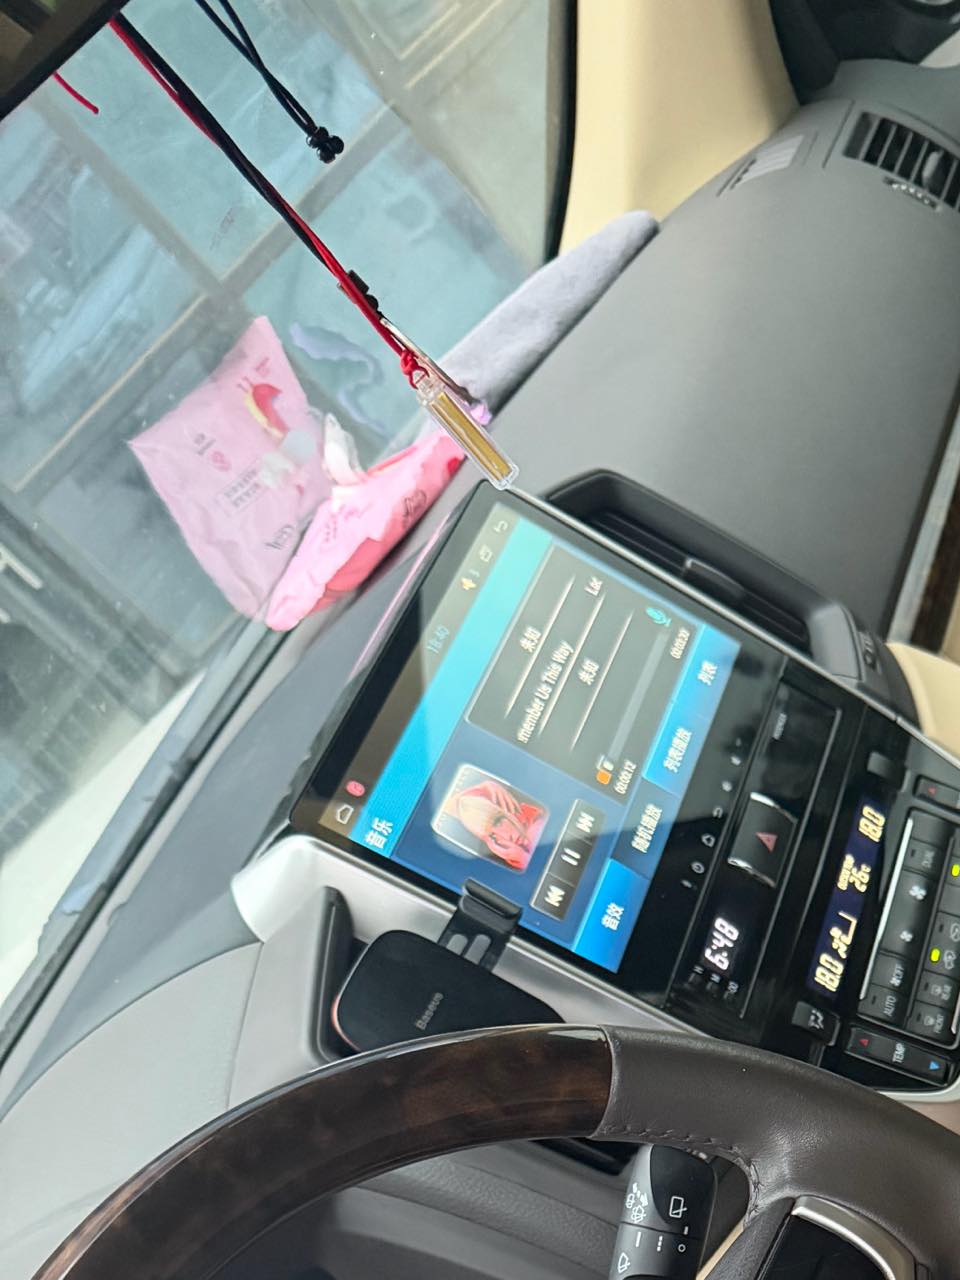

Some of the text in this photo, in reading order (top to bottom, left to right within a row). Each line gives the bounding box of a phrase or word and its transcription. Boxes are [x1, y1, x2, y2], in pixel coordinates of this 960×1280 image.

[519, 626, 542, 653] 未知
[552, 640, 574, 665] Way
[541, 660, 563, 685] This
[578, 658, 600, 686] 未知
[696, 660, 719, 686] 列表
[535, 684, 553, 701] Us
[663, 727, 693, 774] 列表播放
[364, 817, 393, 849] 音乐
[631, 803, 663, 853] 随机播放
[601, 902, 625, 931] 音效
[704, 916, 739, 971] 6:48
[415, 992, 444, 1030] Baseus
[883, 995, 896, 1017] AUTO
[892, 1042, 906, 1063] TEMP
